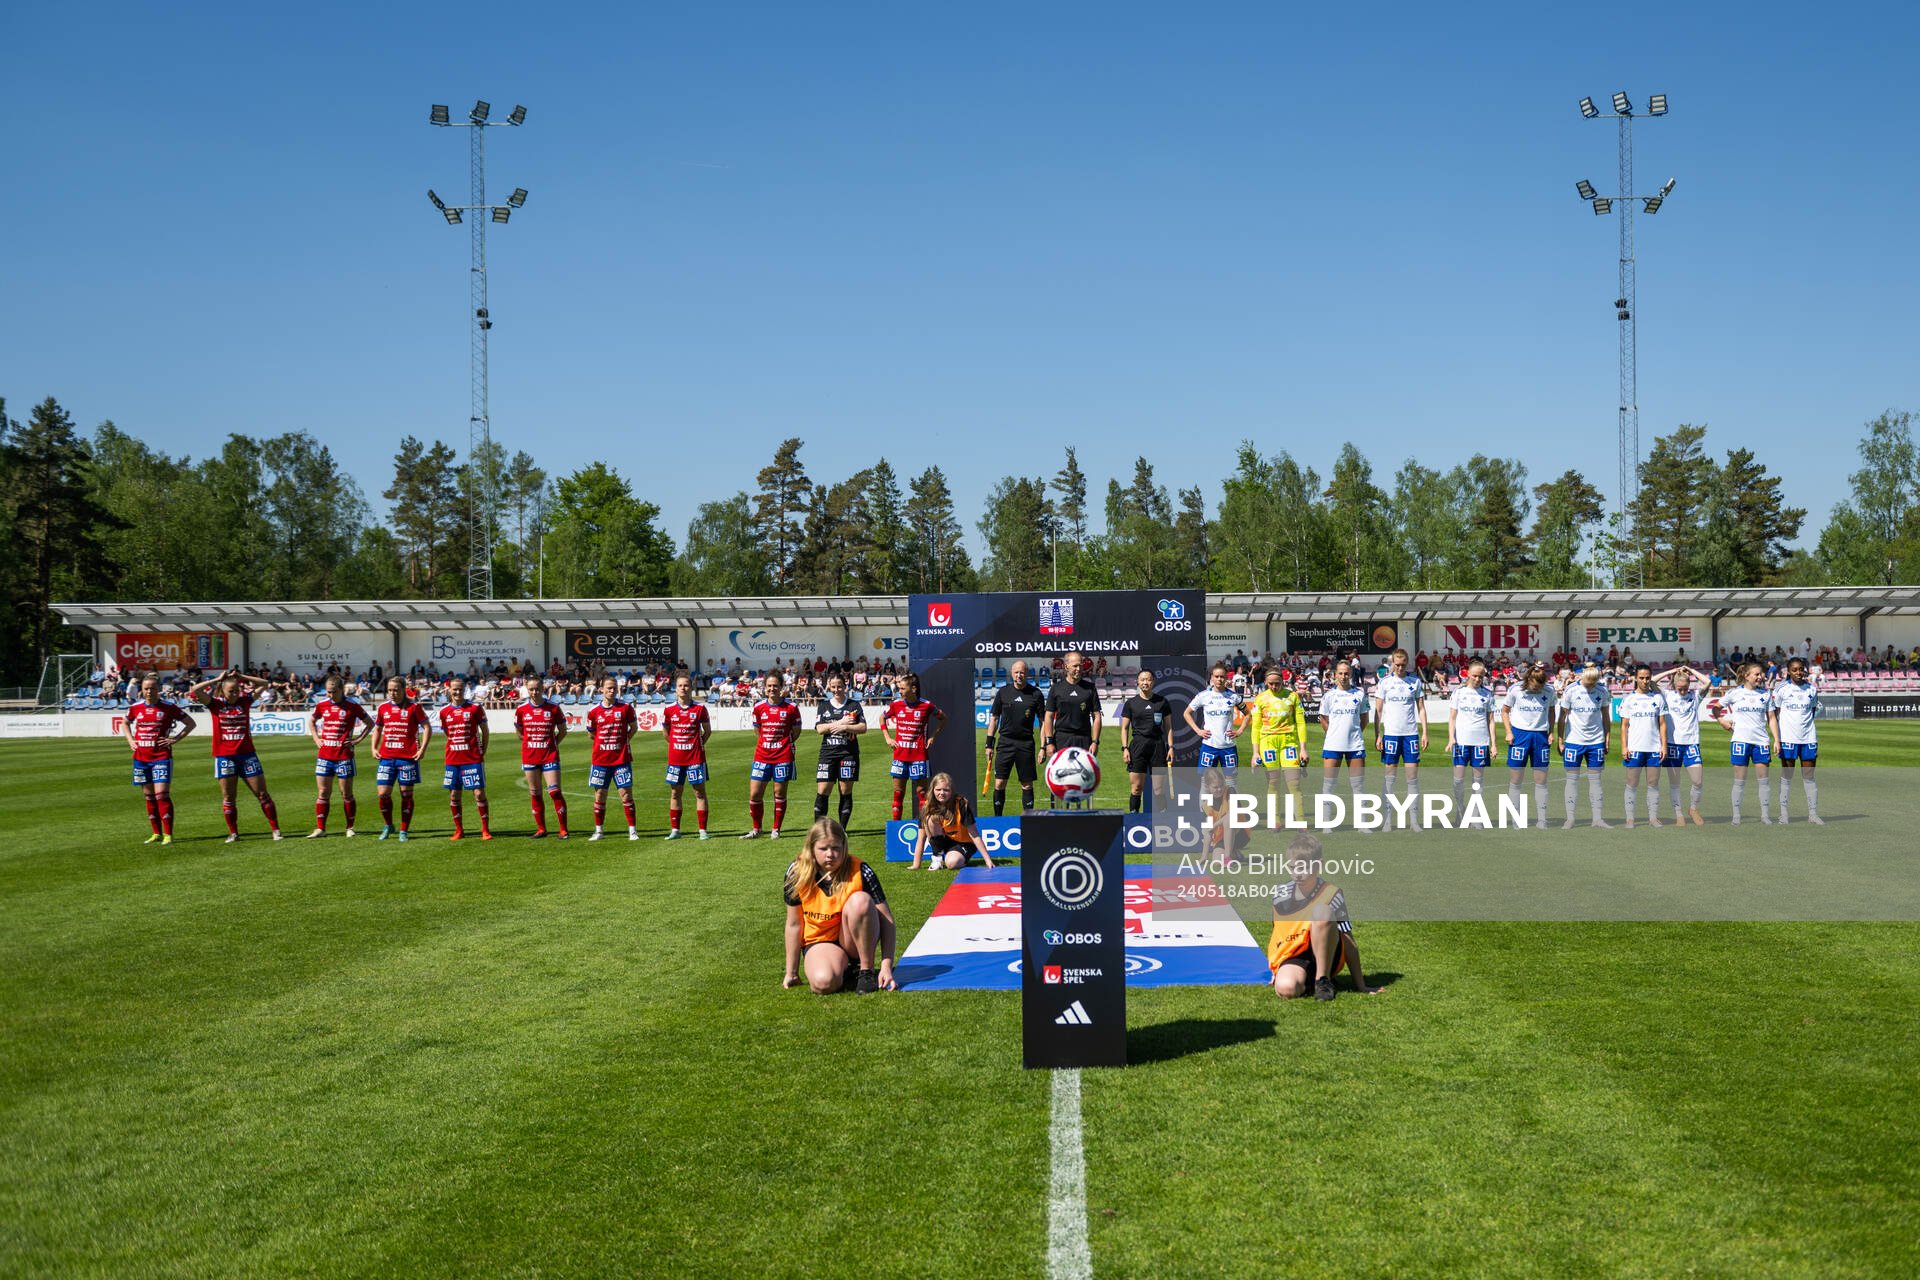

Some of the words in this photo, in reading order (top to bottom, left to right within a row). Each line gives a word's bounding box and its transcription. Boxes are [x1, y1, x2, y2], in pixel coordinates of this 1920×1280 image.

[1154, 620, 1192, 632] OBOS
[596, 632, 671, 645] exakta
[1208, 633, 1247, 641] kommun
[1289, 627, 1365, 638] Snapphanebygdens
[1443, 624, 1540, 649] NIBE
[1598, 627, 1679, 643] PEAB
[749, 641, 777, 652] Vittsjö
[779, 641, 816, 652] Omsorg
[975, 642, 1012, 653] OBOS
[1016, 640, 1139, 652] DAMALLSVENSKAN
[1326, 638, 1365, 648] Sparbank
[120, 641, 179, 658] clean
[596, 645, 671, 656] creative
[297, 653, 351, 661] SUNLIGHT
[1155, 667, 1180, 679] BOS
[249, 723, 301, 731] VSBYHUS
[981, 827, 1021, 851] BO
[1127, 825, 1214, 848] OBO
[1060, 847, 1084, 856] OBOS
[1044, 890, 1101, 911] DAMALLSVENSKAN
[1064, 933, 1103, 945] OBOS
[1063, 968, 1103, 976] SVENSKA
